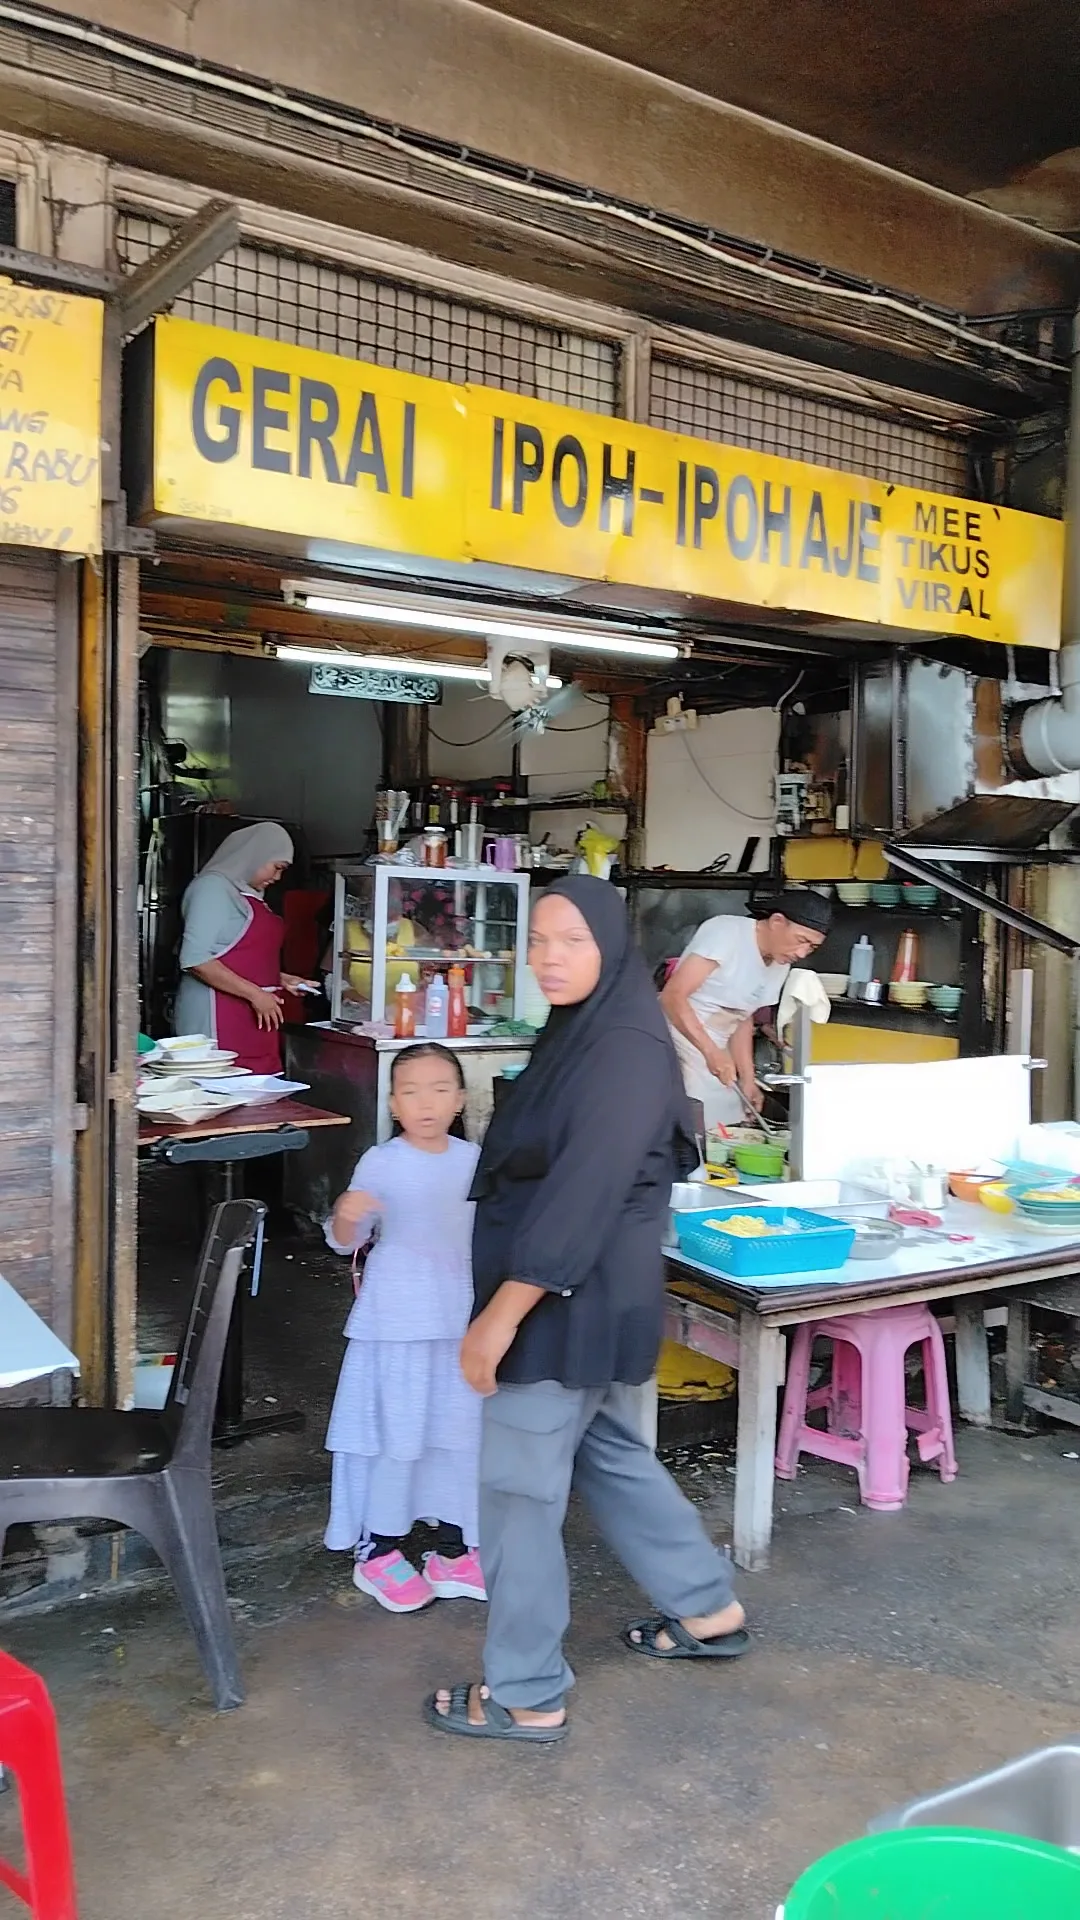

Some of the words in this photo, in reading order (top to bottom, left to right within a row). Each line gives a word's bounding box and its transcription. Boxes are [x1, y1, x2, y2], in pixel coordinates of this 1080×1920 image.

[191, 356, 415, 499] GERAI
[5, 441, 98, 487] RABU
[915, 501, 982, 542] MEE
[896, 535, 990, 579] TIKUS
[896, 577, 991, 621] VIRAL
